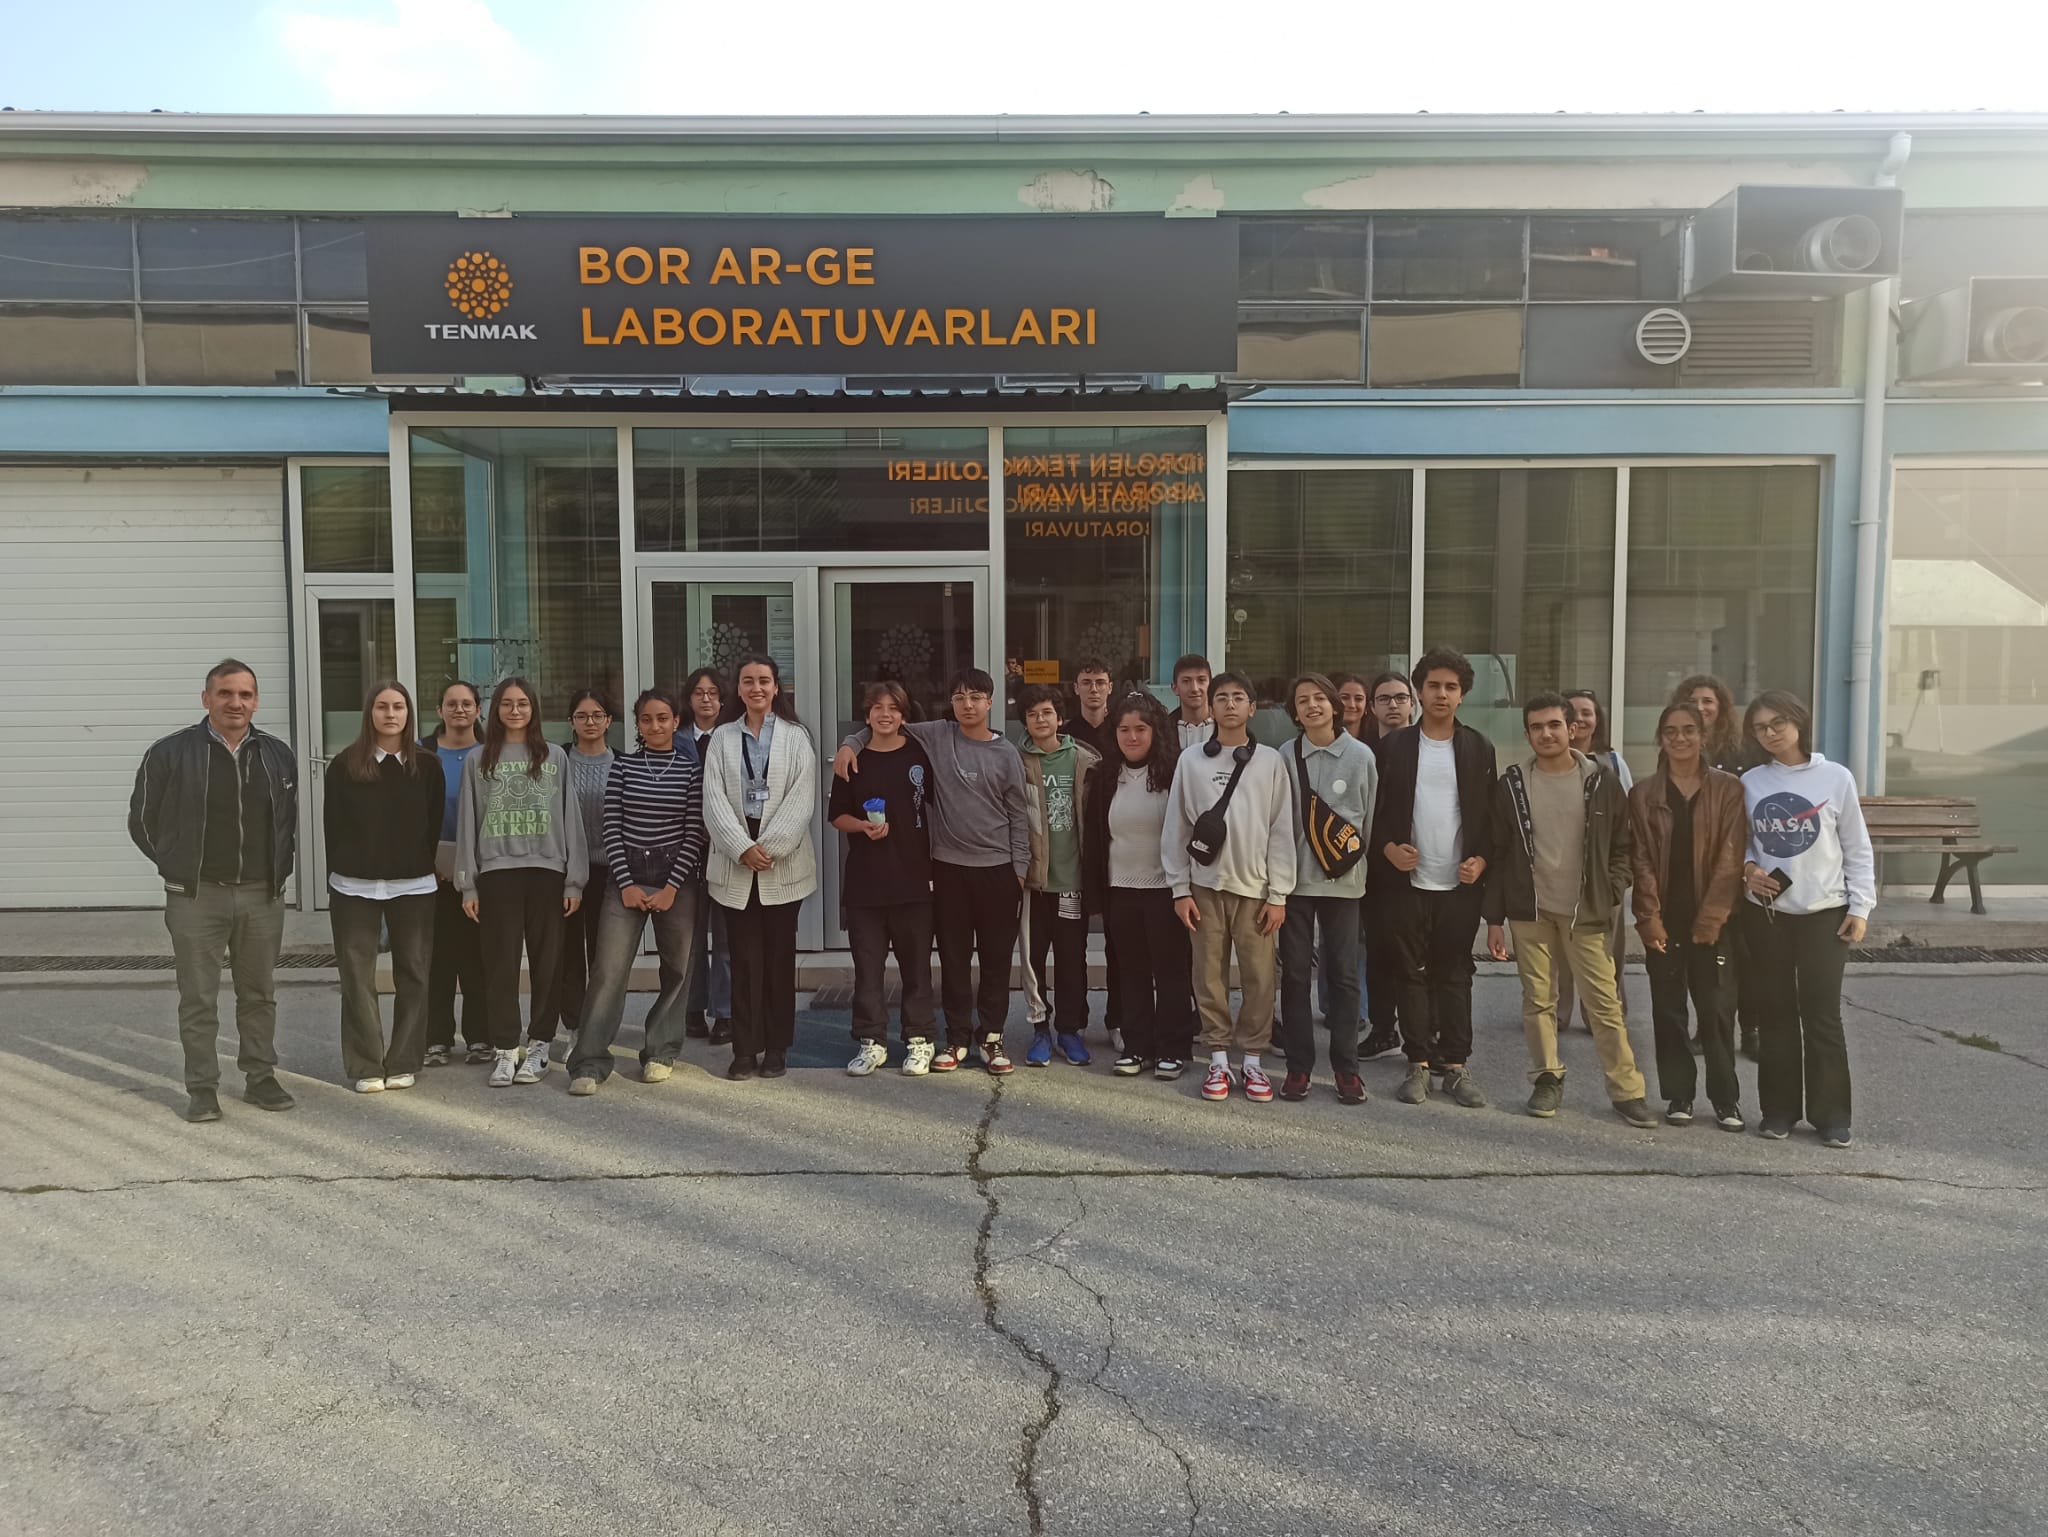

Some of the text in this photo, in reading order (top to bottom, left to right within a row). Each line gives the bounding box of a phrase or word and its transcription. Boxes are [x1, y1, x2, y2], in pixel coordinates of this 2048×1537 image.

[579, 246, 875, 286] BOR AR-GE
[423, 324, 538, 340] TENMAK
[582, 307, 1096, 346] LABORATUVARLARI
[500, 810, 536, 823] KIND
[510, 822, 549, 836] KIND
[1755, 817, 1816, 833] NASA
